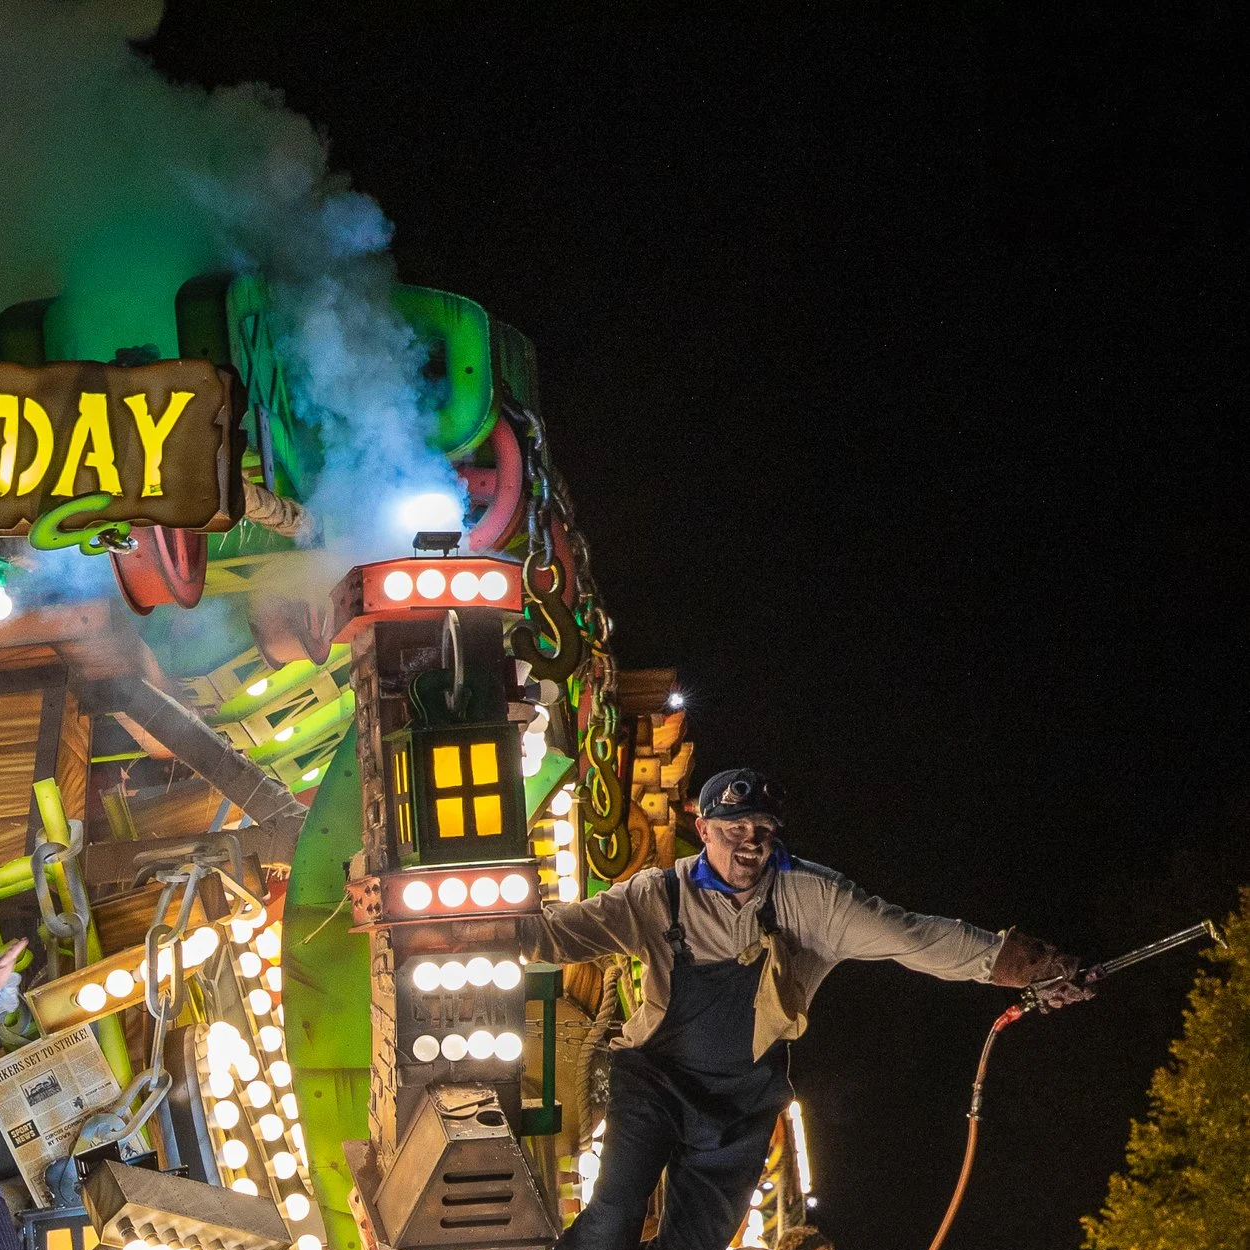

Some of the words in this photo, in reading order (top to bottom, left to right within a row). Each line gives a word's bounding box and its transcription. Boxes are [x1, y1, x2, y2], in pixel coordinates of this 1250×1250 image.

[24, 1054, 42, 1069] SET
[41, 1046, 55, 1060] TO
[54, 1028, 90, 1054] STRIKE!
[10, 1121, 35, 1138] SPORT
[44, 1128, 64, 1141] CIRCUS
[14, 1131, 36, 1146] NEWS
